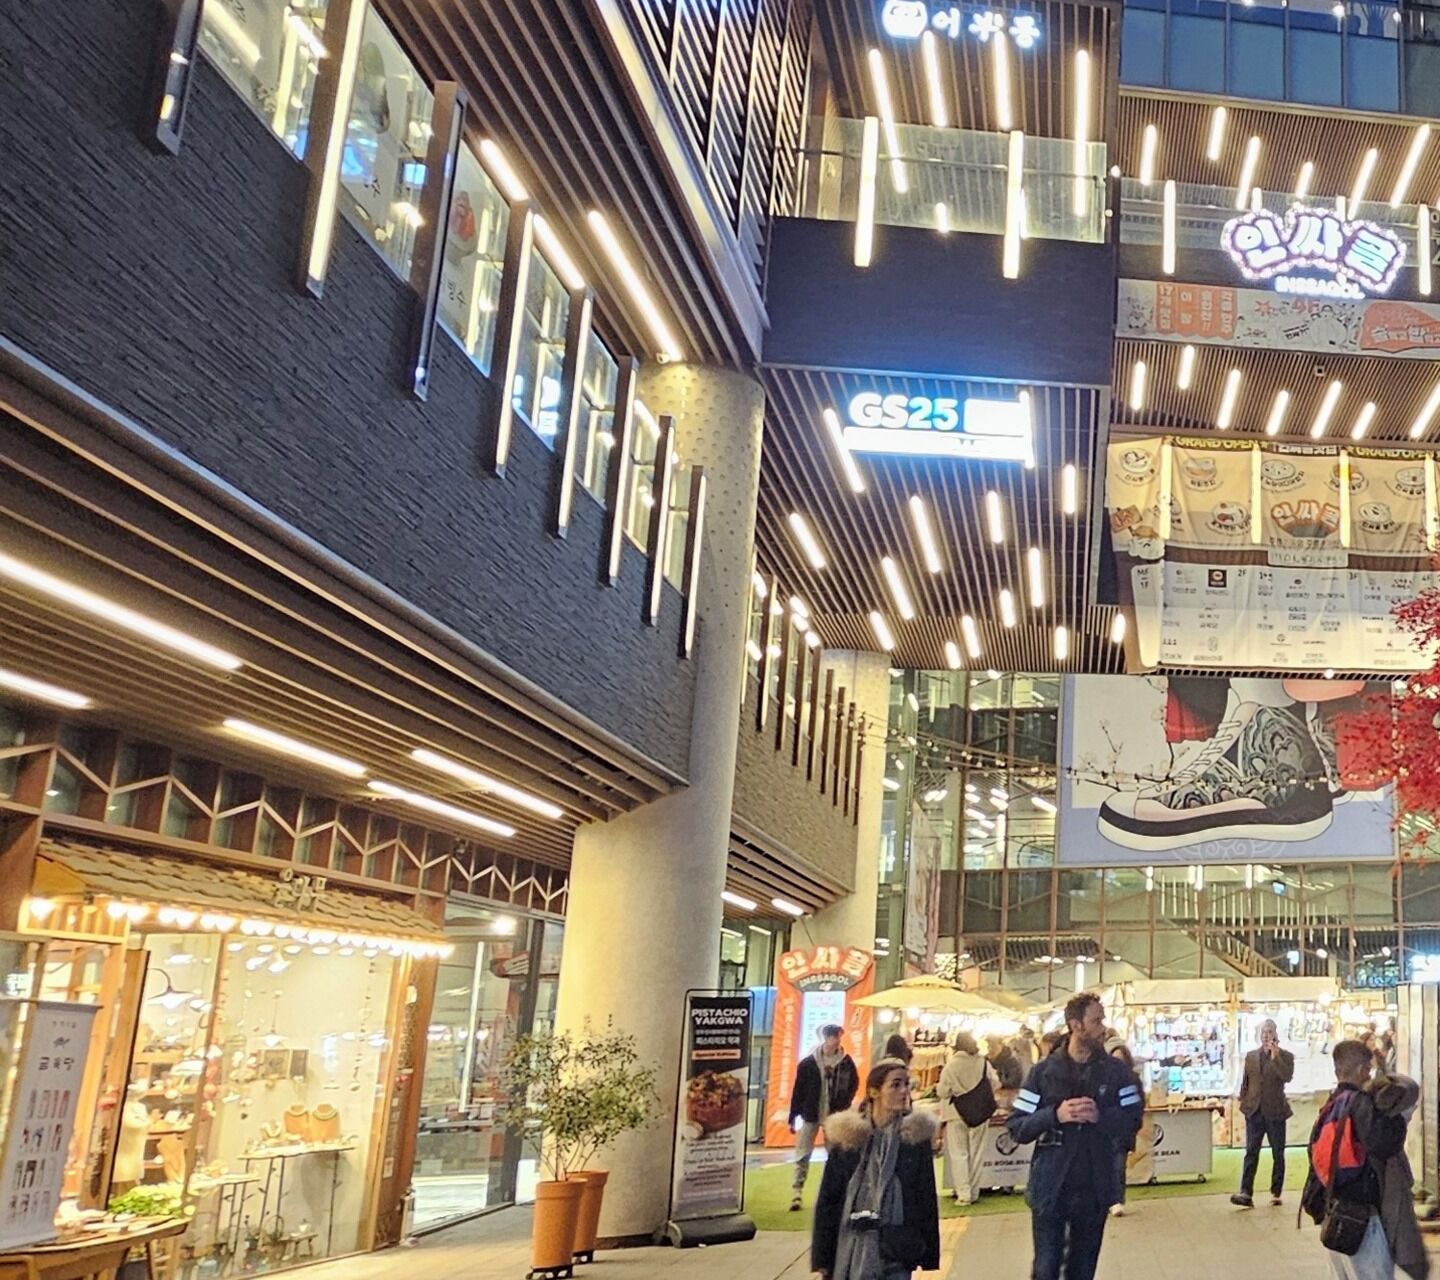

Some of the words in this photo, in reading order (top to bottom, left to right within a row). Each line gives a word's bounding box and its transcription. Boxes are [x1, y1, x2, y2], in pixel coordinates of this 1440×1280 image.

[848, 391, 959, 432] GS25
[691, 1008, 749, 1017] PISTACHIO
[694, 1016, 744, 1025] YAKGWA
